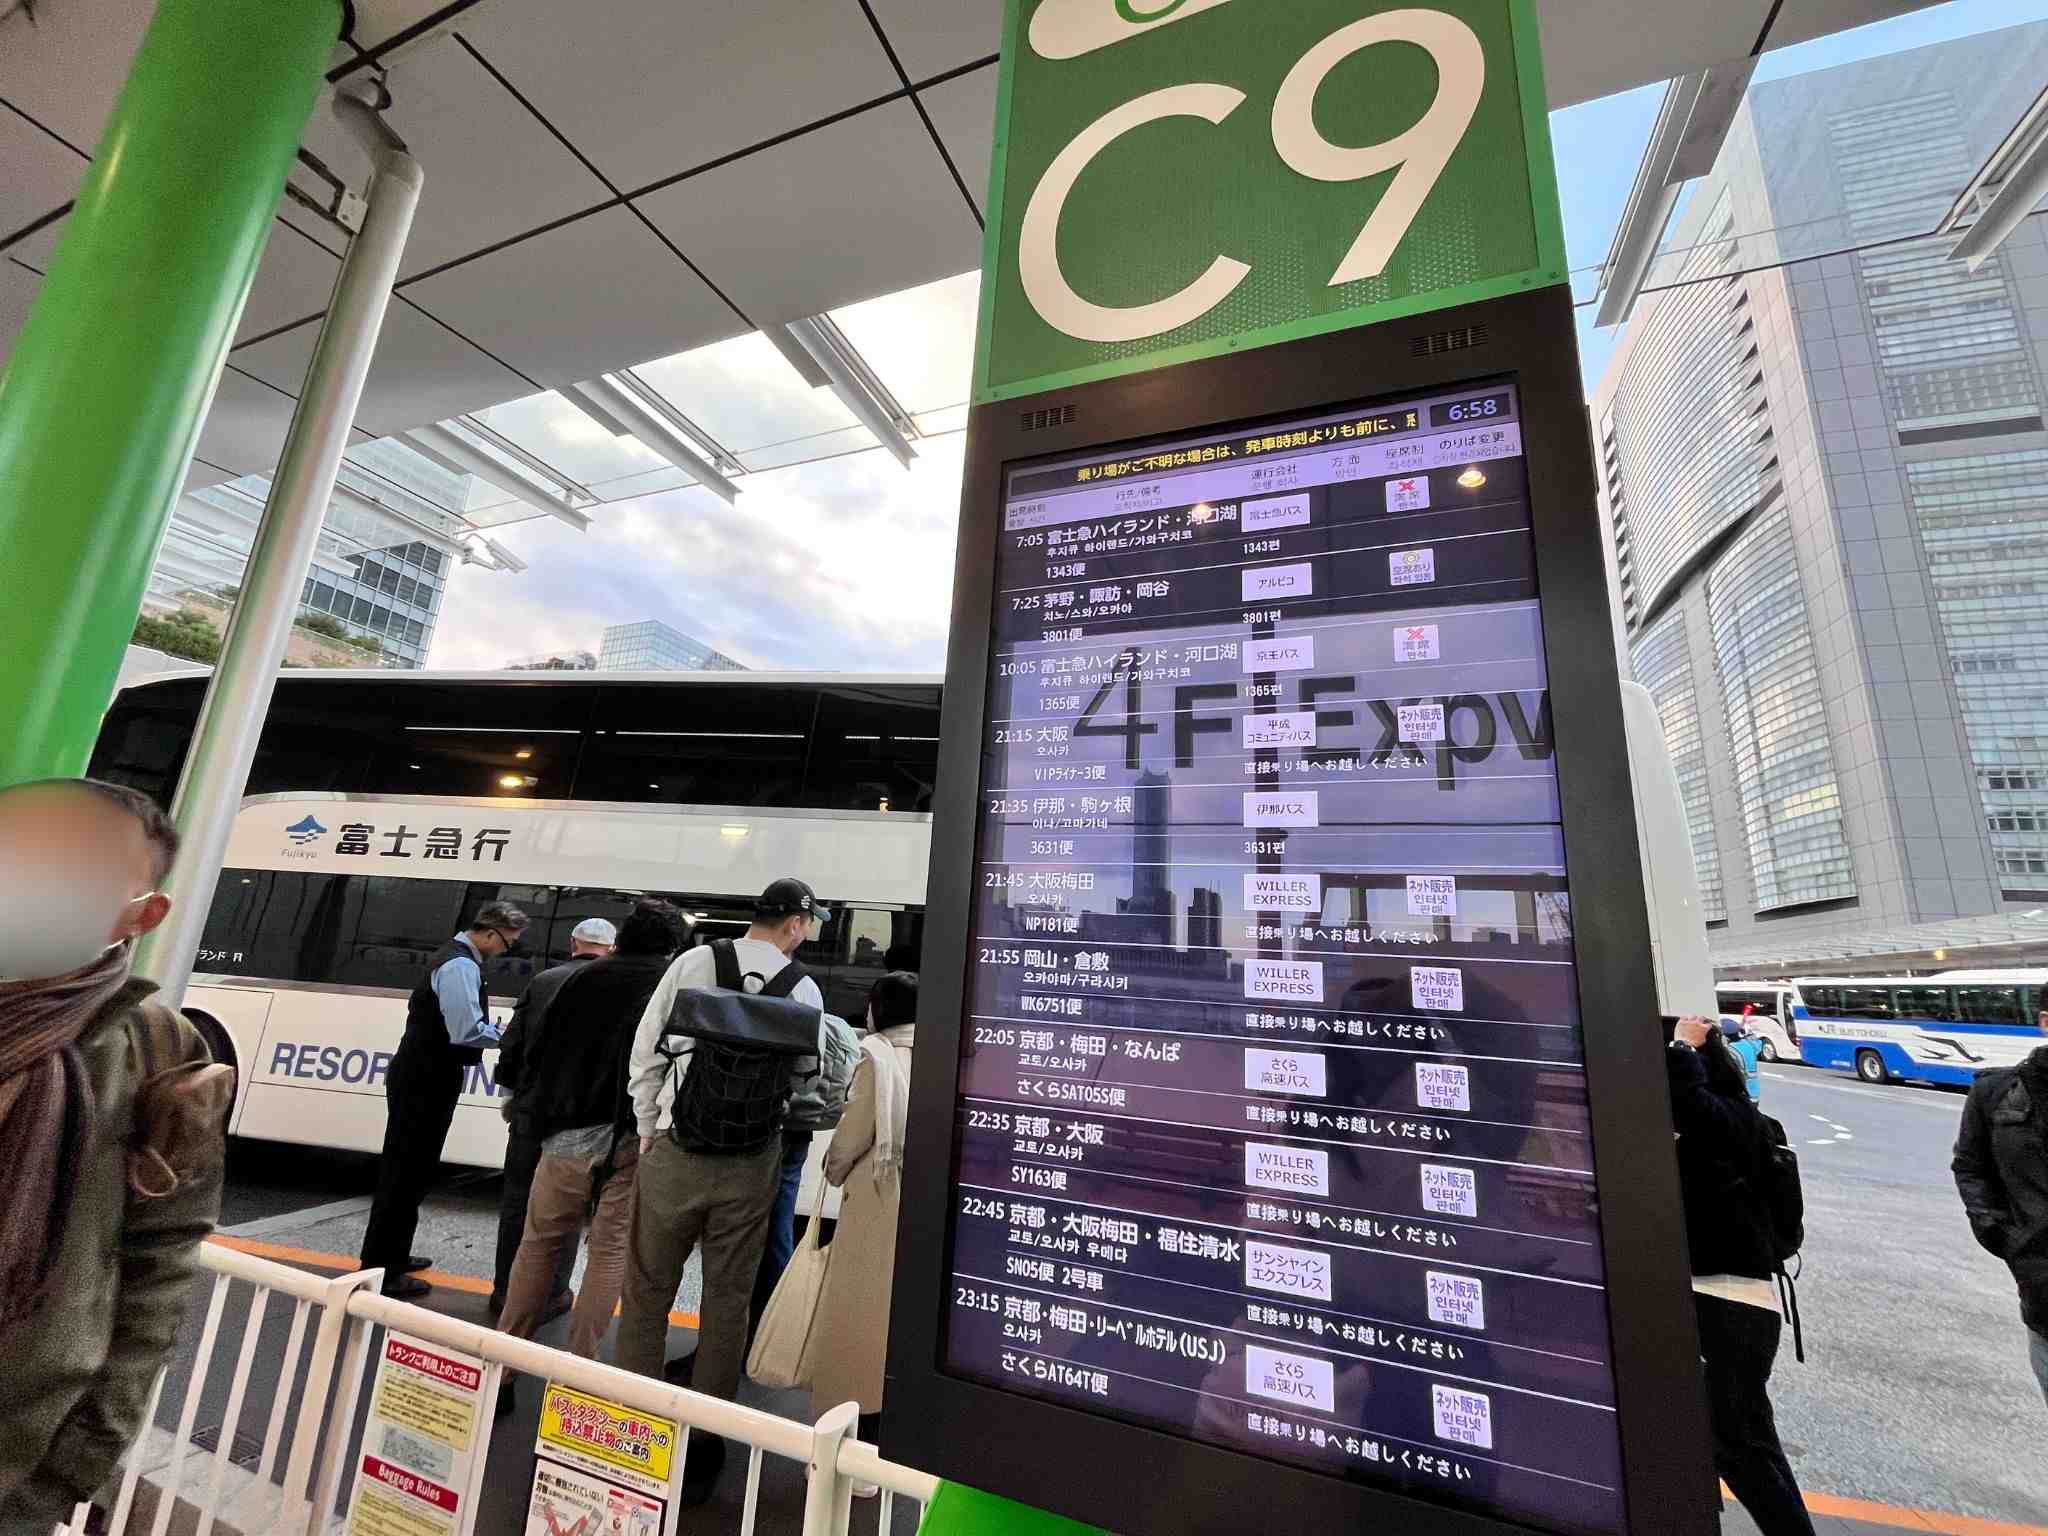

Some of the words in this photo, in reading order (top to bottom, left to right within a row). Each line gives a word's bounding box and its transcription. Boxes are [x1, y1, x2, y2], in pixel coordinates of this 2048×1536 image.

[1018, 8, 1485, 342] C9
[1449, 399, 1497, 421] 6:58
[1047, 504, 1237, 545] 富士急ハイランド・河口湖
[1016, 533, 1043, 549] 7:05
[1046, 563, 1086, 579] 1343便
[1012, 596, 1040, 610] 7:25
[1043, 581, 1170, 608] 茅野・諏訪・岡谷
[1043, 602, 1132, 622] 치노/스와/오카야
[1242, 609, 1281, 624] 3801편
[1041, 627, 1083, 644] 3801便
[1040, 643, 1237, 675] 富士急ハイランド・河口湖
[1000, 661, 1036, 677] 10:05
[1244, 683, 1282, 698] 1365편
[1039, 696, 1080, 711] 1365便
[994, 729, 1033, 743] 21:15
[1036, 725, 1069, 743] 大阪
[1036, 745, 1070, 757] 오사카
[1244, 757, 1428, 776] 直接乗り場へお越しください
[990, 799, 1028, 814] 21:35
[1256, 803, 1306, 817] 伊那バス
[335, 824, 512, 861] 富士急行
[1031, 840, 1074, 856] 3631便
[1244, 841, 1286, 855] 3631편
[985, 873, 1025, 888] 21:45
[1028, 872, 1095, 891] 大阪梅田
[1256, 880, 1309, 893] WILLER
[1027, 894, 1063, 905] 오사카
[1253, 894, 1313, 907] EXPRESS
[1025, 916, 1079, 934] NP181便
[1245, 926, 1439, 946] 直接乗り場へお越しください
[979, 949, 1020, 965] 21:55
[1023, 949, 1110, 972] 岡山・倉敷
[1023, 971, 1129, 991] 오카야마/구라시키
[1256, 967, 1310, 980] WILLER
[1253, 981, 1315, 995] EXPRESS
[1021, 995, 1083, 1016] WK6751便
[1245, 1013, 1446, 1040] 直接乗り場へお越しください
[974, 1027, 1015, 1046] 22:05
[1018, 1053, 1088, 1072] 교토/오사카
[1270, 1058, 1298, 1072] さくら
[1260, 1073, 1311, 1089] 高速バス
[968, 1110, 1010, 1130] 22:35
[1246, 1105, 1451, 1141] 直接乗り場へお越しください
[1014, 1114, 1105, 1146] 京都・大阪
[1012, 1139, 1085, 1161] 교토/오사카
[1258, 1152, 1315, 1171] WILLER
[1011, 1165, 1067, 1191] SY163便
[1255, 1168, 1320, 1187] EXPRESS
[1429, 1187, 1468, 1201] 인터넷
[962, 1197, 1005, 1219] 22:45
[1009, 1203, 1241, 1263] 京都・大阪梅田・福住清水
[1247, 1203, 1457, 1247] 直接乗り場へお越しください
[1008, 1228, 1080, 1255] 교토/오사카
[1086, 1241, 1128, 1264] 우메다
[1251, 1249, 1324, 1274] サンシャイン
[1006, 1256, 1055, 1283] SN05便
[1061, 1267, 1104, 1292] 2号車
[1251, 1268, 1325, 1293] エクスプレス
[956, 1287, 1000, 1313] 23:15
[1435, 1296, 1475, 1314] 인터넷
[1002, 1322, 1042, 1345] 오사카
[1247, 1304, 1465, 1360] 直接乗り場へお越しください
[1001, 1352, 1110, 1396] さくらAT64T便
[1273, 1359, 1305, 1380] さくら
[1263, 1375, 1317, 1401] 高速バス
[1442, 1411, 1482, 1433] 인터넷
[1247, 1412, 1472, 1480] 直接乗り場へお越しください
[378, 1463, 415, 1489] Baggage
[416, 1480, 441, 1502] Rules
